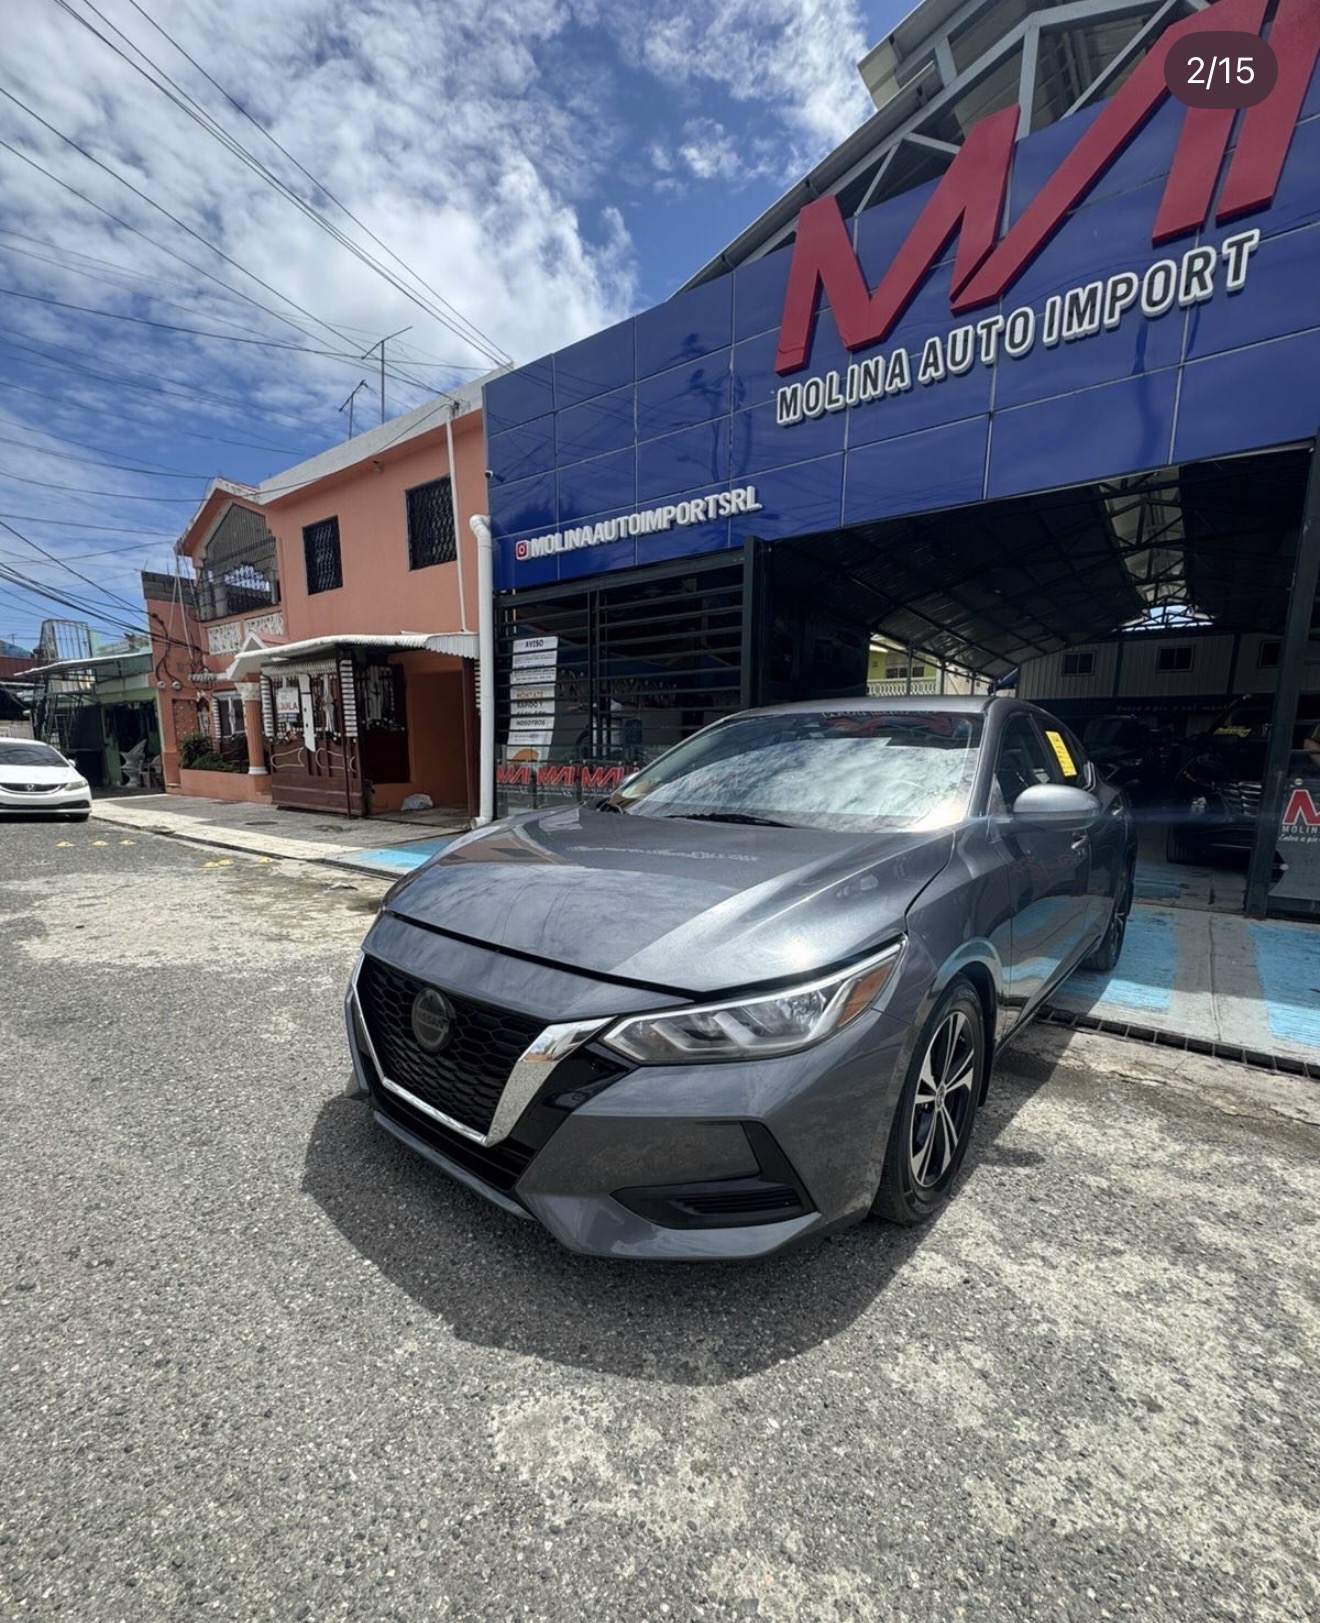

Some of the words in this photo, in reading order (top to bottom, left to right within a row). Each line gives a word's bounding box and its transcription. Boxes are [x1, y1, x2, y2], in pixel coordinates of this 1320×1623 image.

[776, 348, 911, 426] MOLINA
[917, 305, 1035, 382] AUTO
[1042, 229, 1261, 349] IMPORT
[530, 486, 763, 559] MOLINAAUTOIMPORTSRL
[525, 639, 545, 648] AVISO
[1282, 825, 1320, 834] MOLIN
